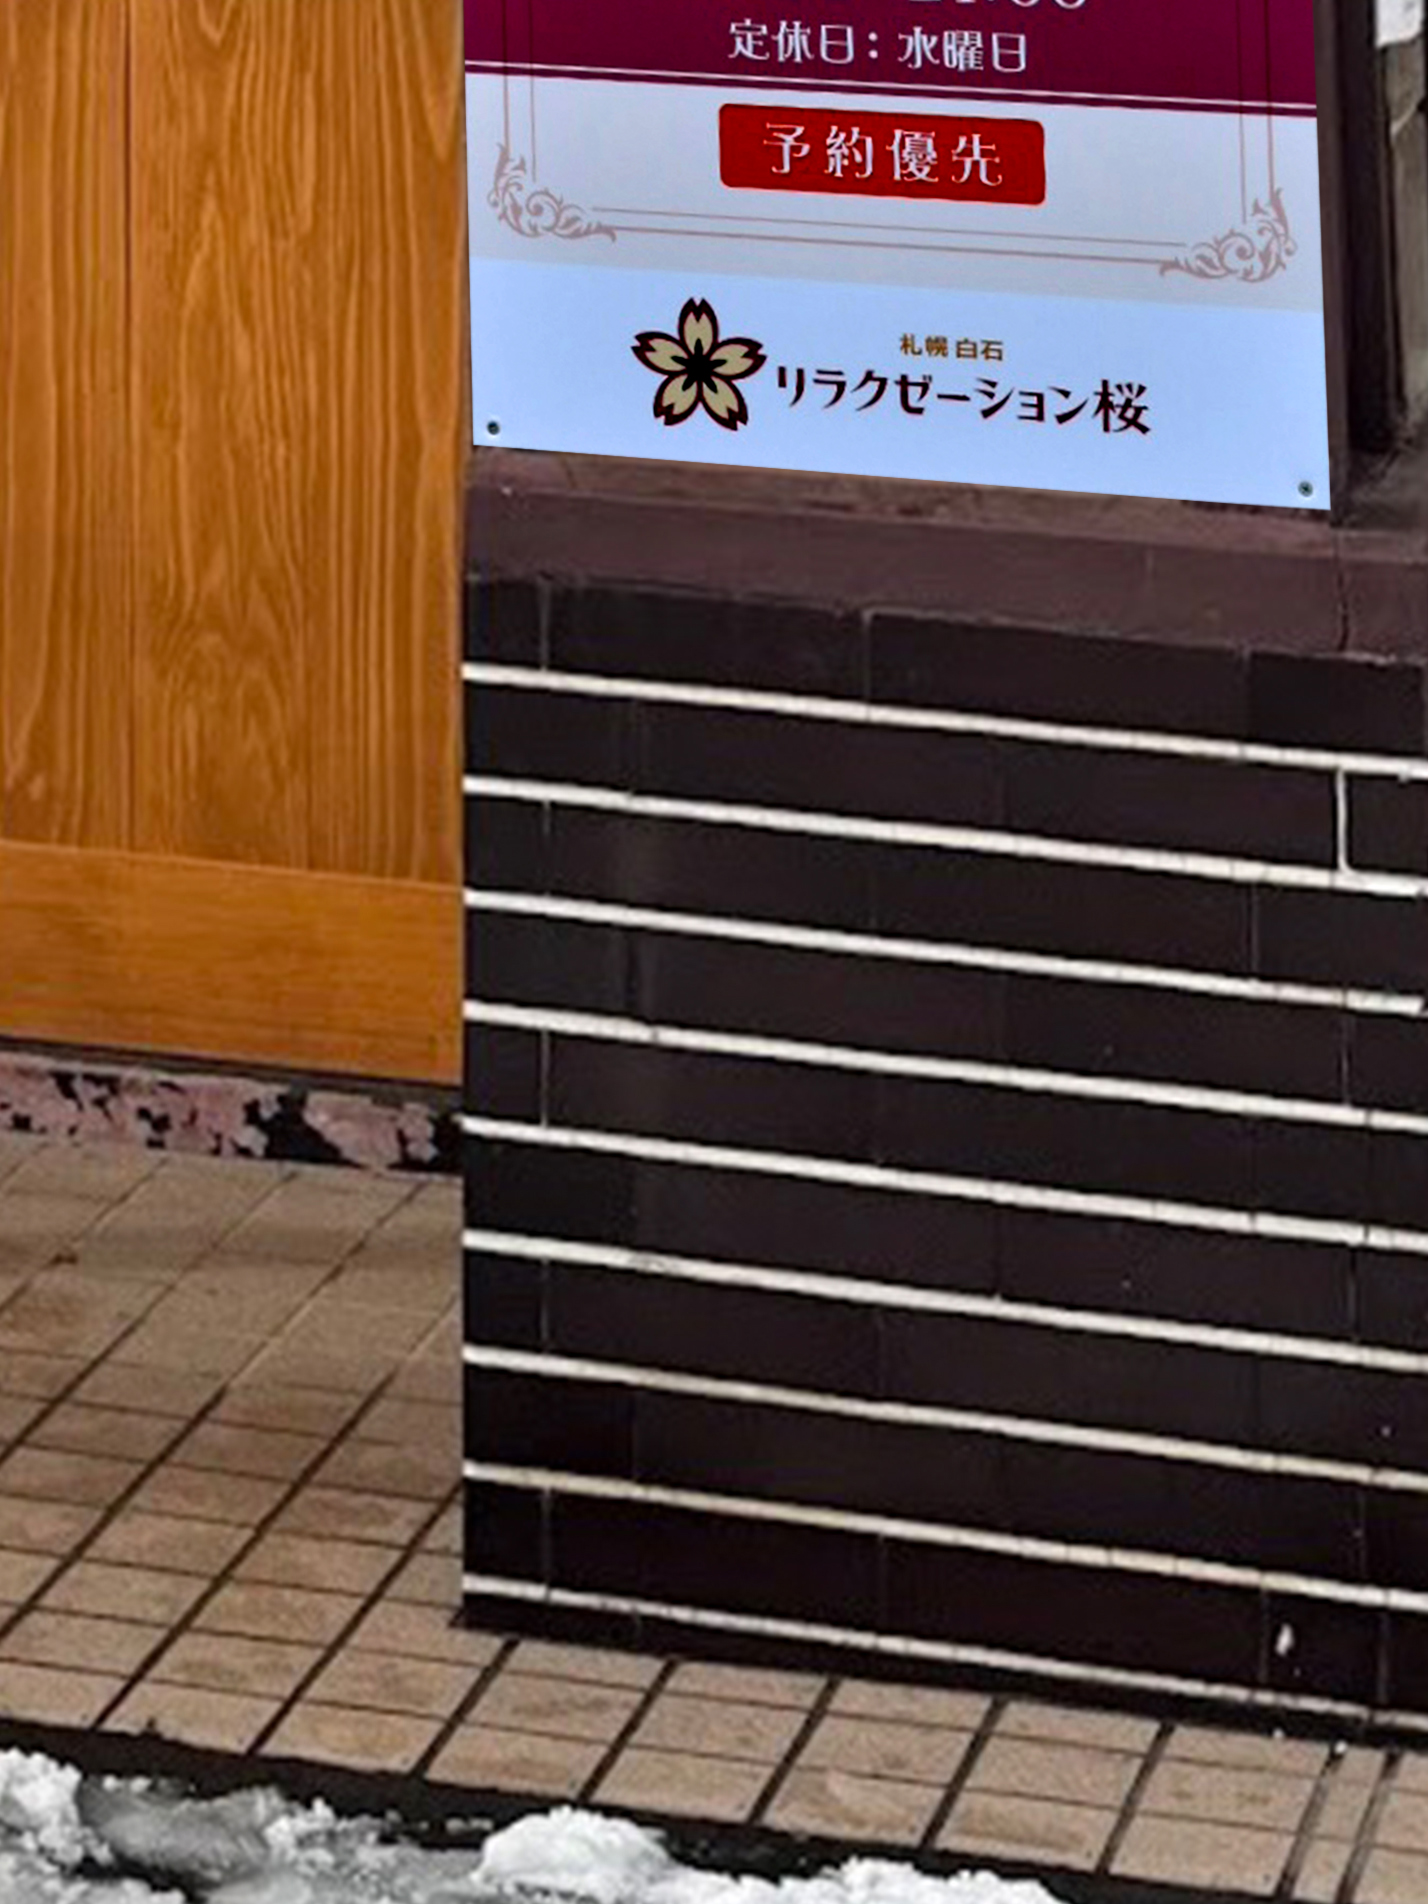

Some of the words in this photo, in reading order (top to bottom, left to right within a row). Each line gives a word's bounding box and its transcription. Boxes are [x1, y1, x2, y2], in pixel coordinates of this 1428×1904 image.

[765, 124, 1001, 185] 予約優先
[778, 366, 1150, 434] リラクゼーション桜
